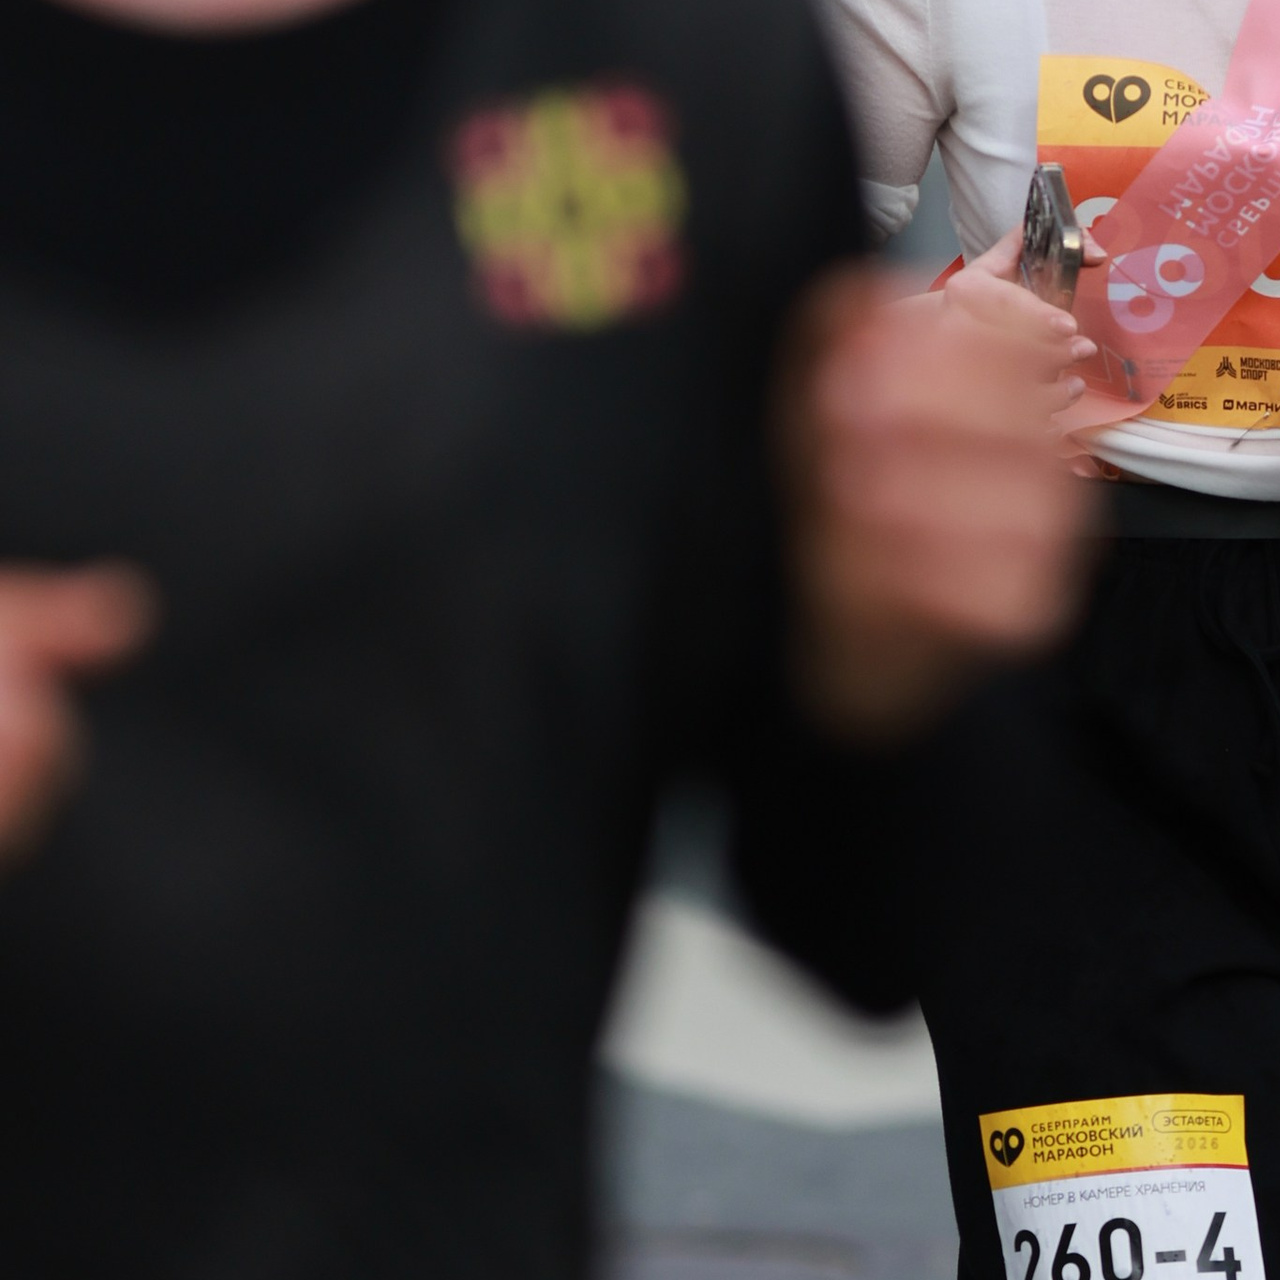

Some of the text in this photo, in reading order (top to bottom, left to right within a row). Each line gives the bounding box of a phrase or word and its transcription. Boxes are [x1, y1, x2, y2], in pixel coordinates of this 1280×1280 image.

[1240, 369, 1268, 381] СПОРТ
[1176, 401, 1208, 410] BRICS
[1031, 1115, 1112, 1134] СБЕРПРАЙМ
[1162, 1115, 1224, 1128] ЭСТАФЕТА
[1032, 1124, 1144, 1149] МОСКОВСКИЙ
[1175, 1136, 1220, 1151] 2026
[1033, 1143, 1115, 1164] МАРАФОН
[1023, 1181, 1207, 1209] НОМЕР В КАМЕРЕ ХРАНЕНИЯ
